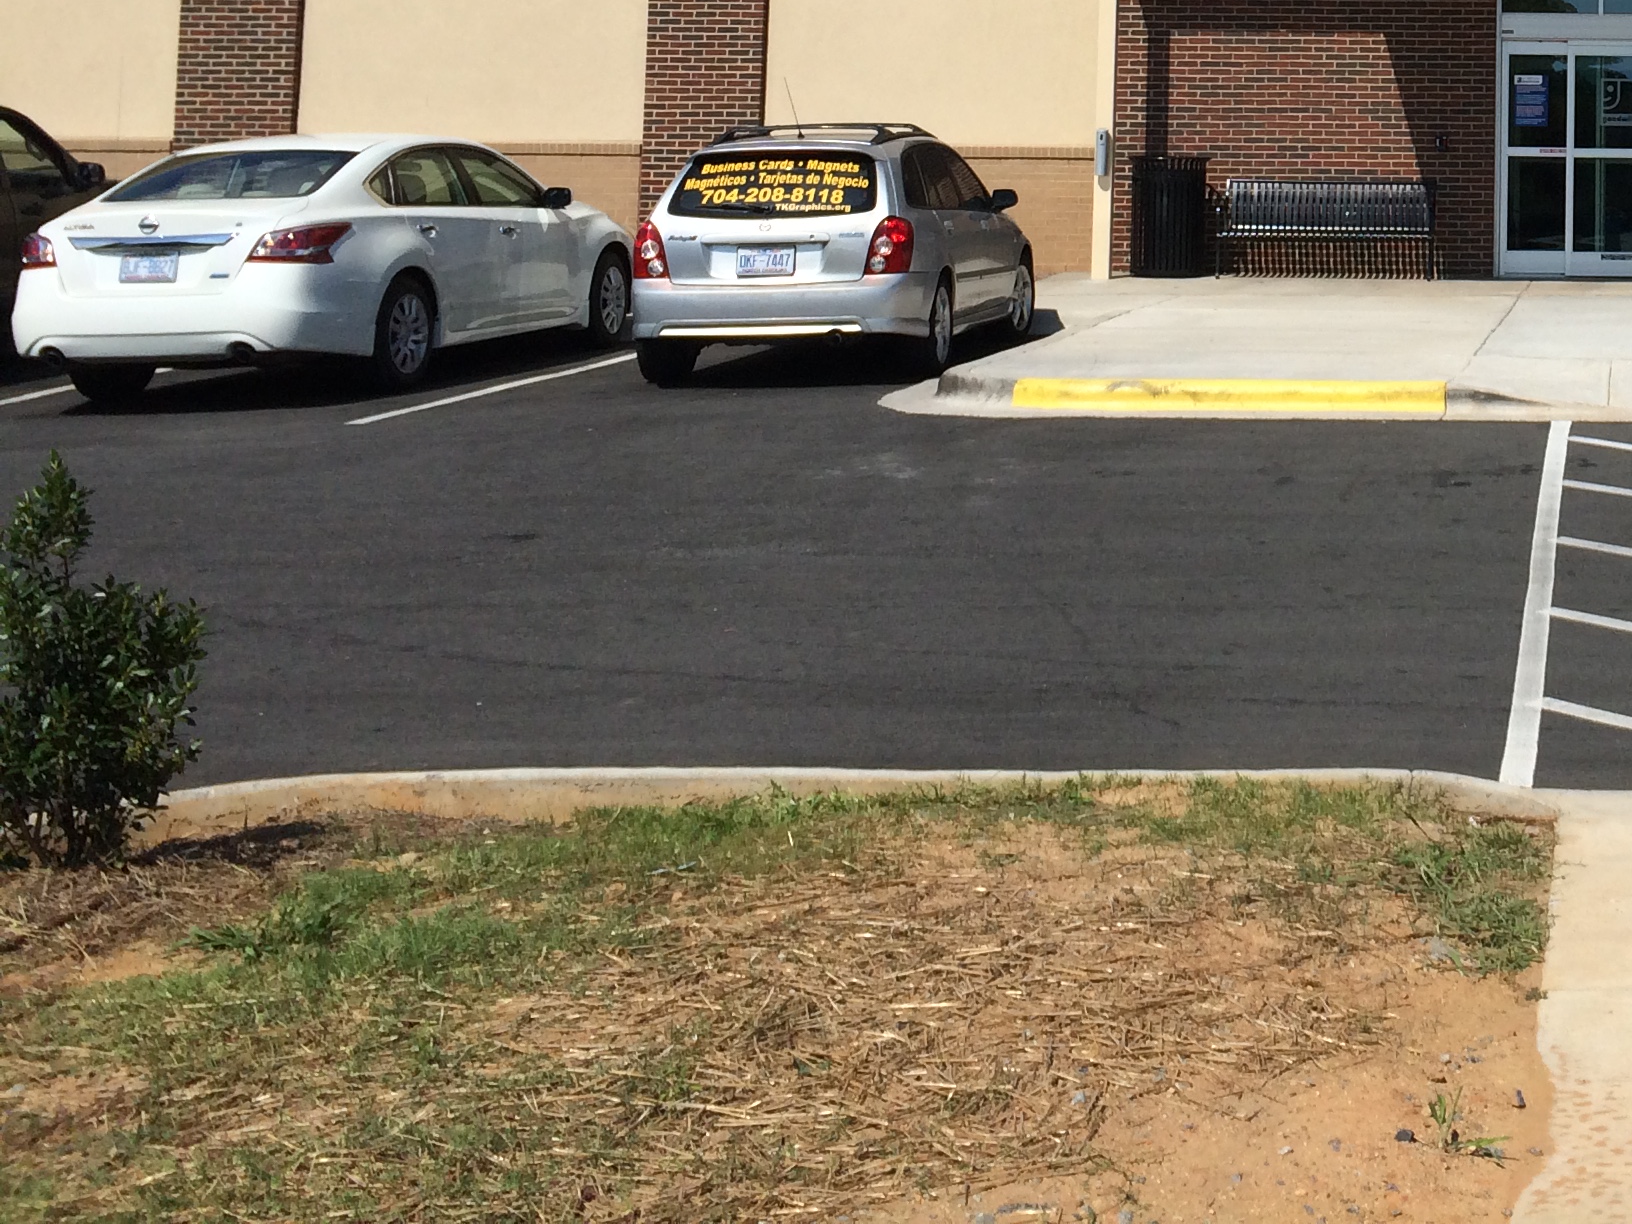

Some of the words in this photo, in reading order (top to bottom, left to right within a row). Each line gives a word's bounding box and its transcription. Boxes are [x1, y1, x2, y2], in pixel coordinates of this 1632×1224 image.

[701, 161, 755, 174] Business
[758, 159, 794, 171] Cards
[806, 160, 860, 173] Magnets
[684, 175, 747, 191] Magnéticos
[758, 172, 803, 186] Tarjetas
[805, 173, 820, 185] de
[822, 174, 869, 189] Negocio
[701, 187, 845, 205] 704-208-8118
[775, 203, 852, 213] TKGraphics.org
